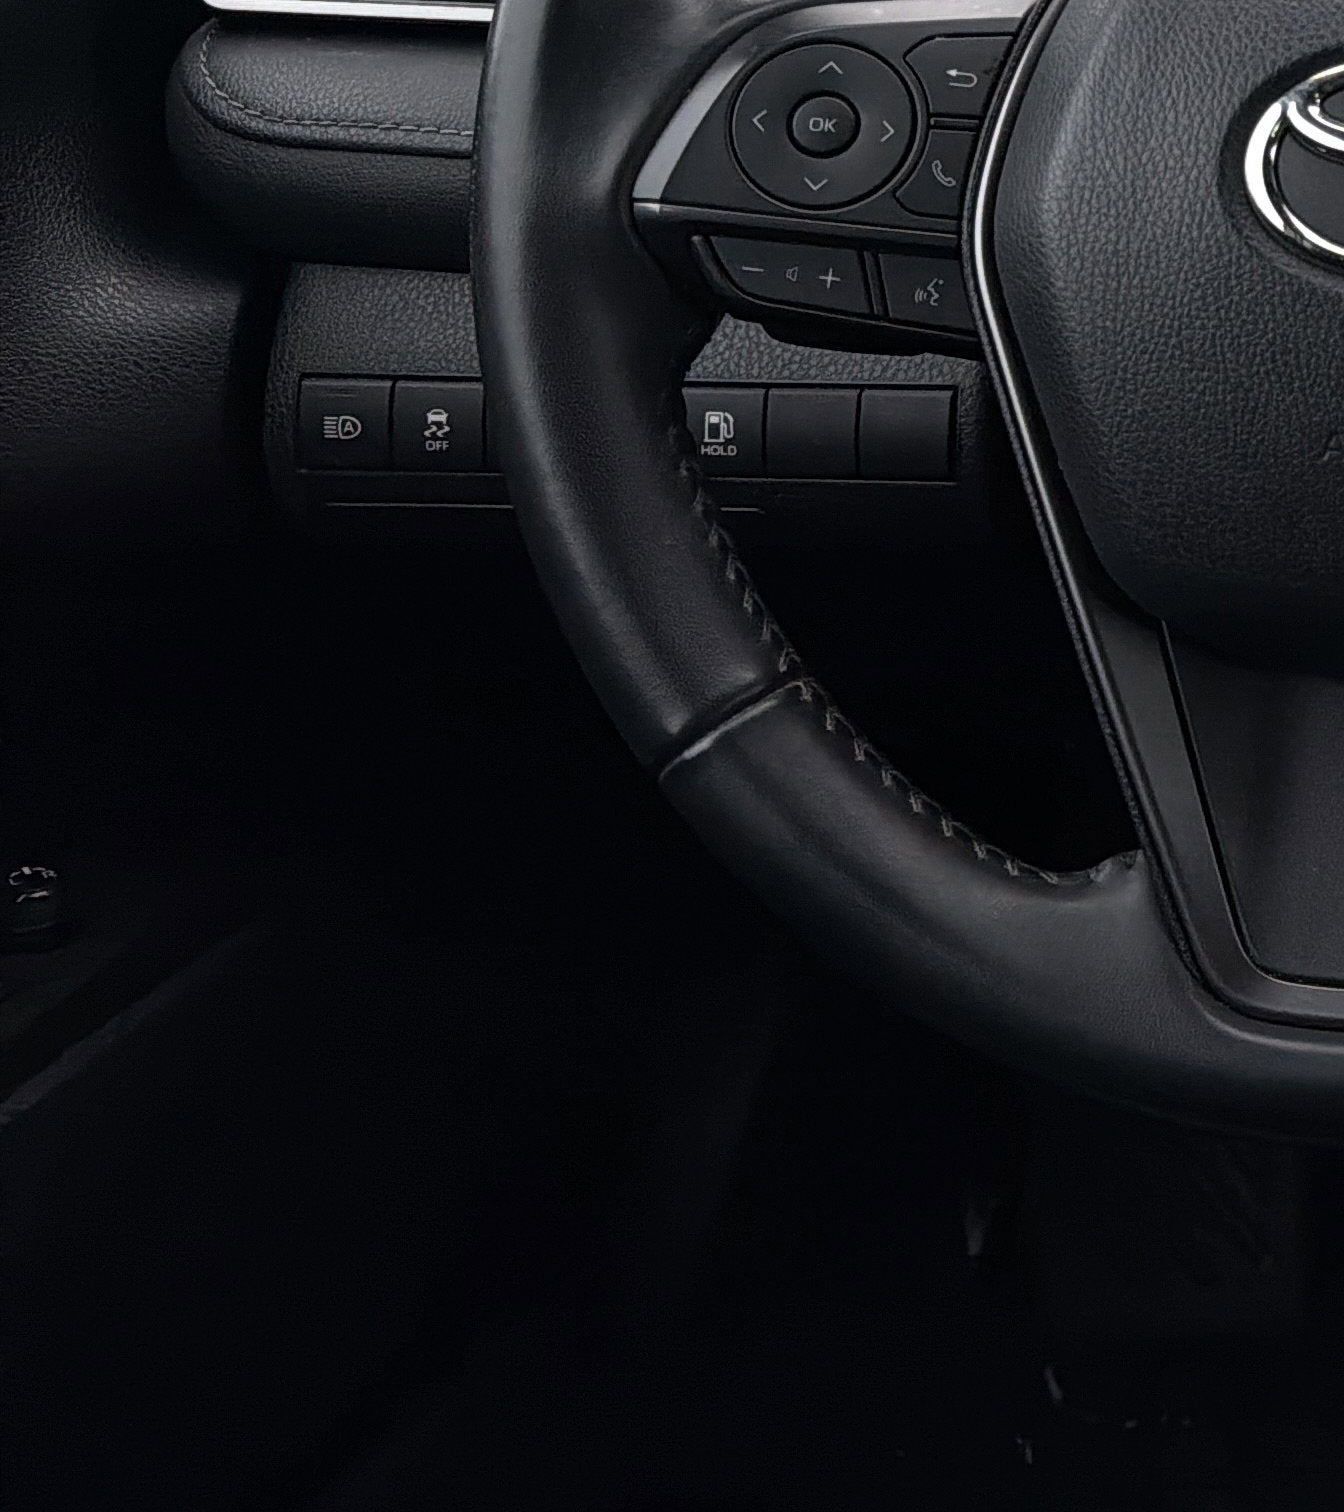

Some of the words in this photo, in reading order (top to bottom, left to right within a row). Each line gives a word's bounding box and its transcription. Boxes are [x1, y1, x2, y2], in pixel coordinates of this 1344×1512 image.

[808, 117, 837, 133] OK
[425, 439, 451, 452] OFF
[700, 444, 738, 456] HOLD
